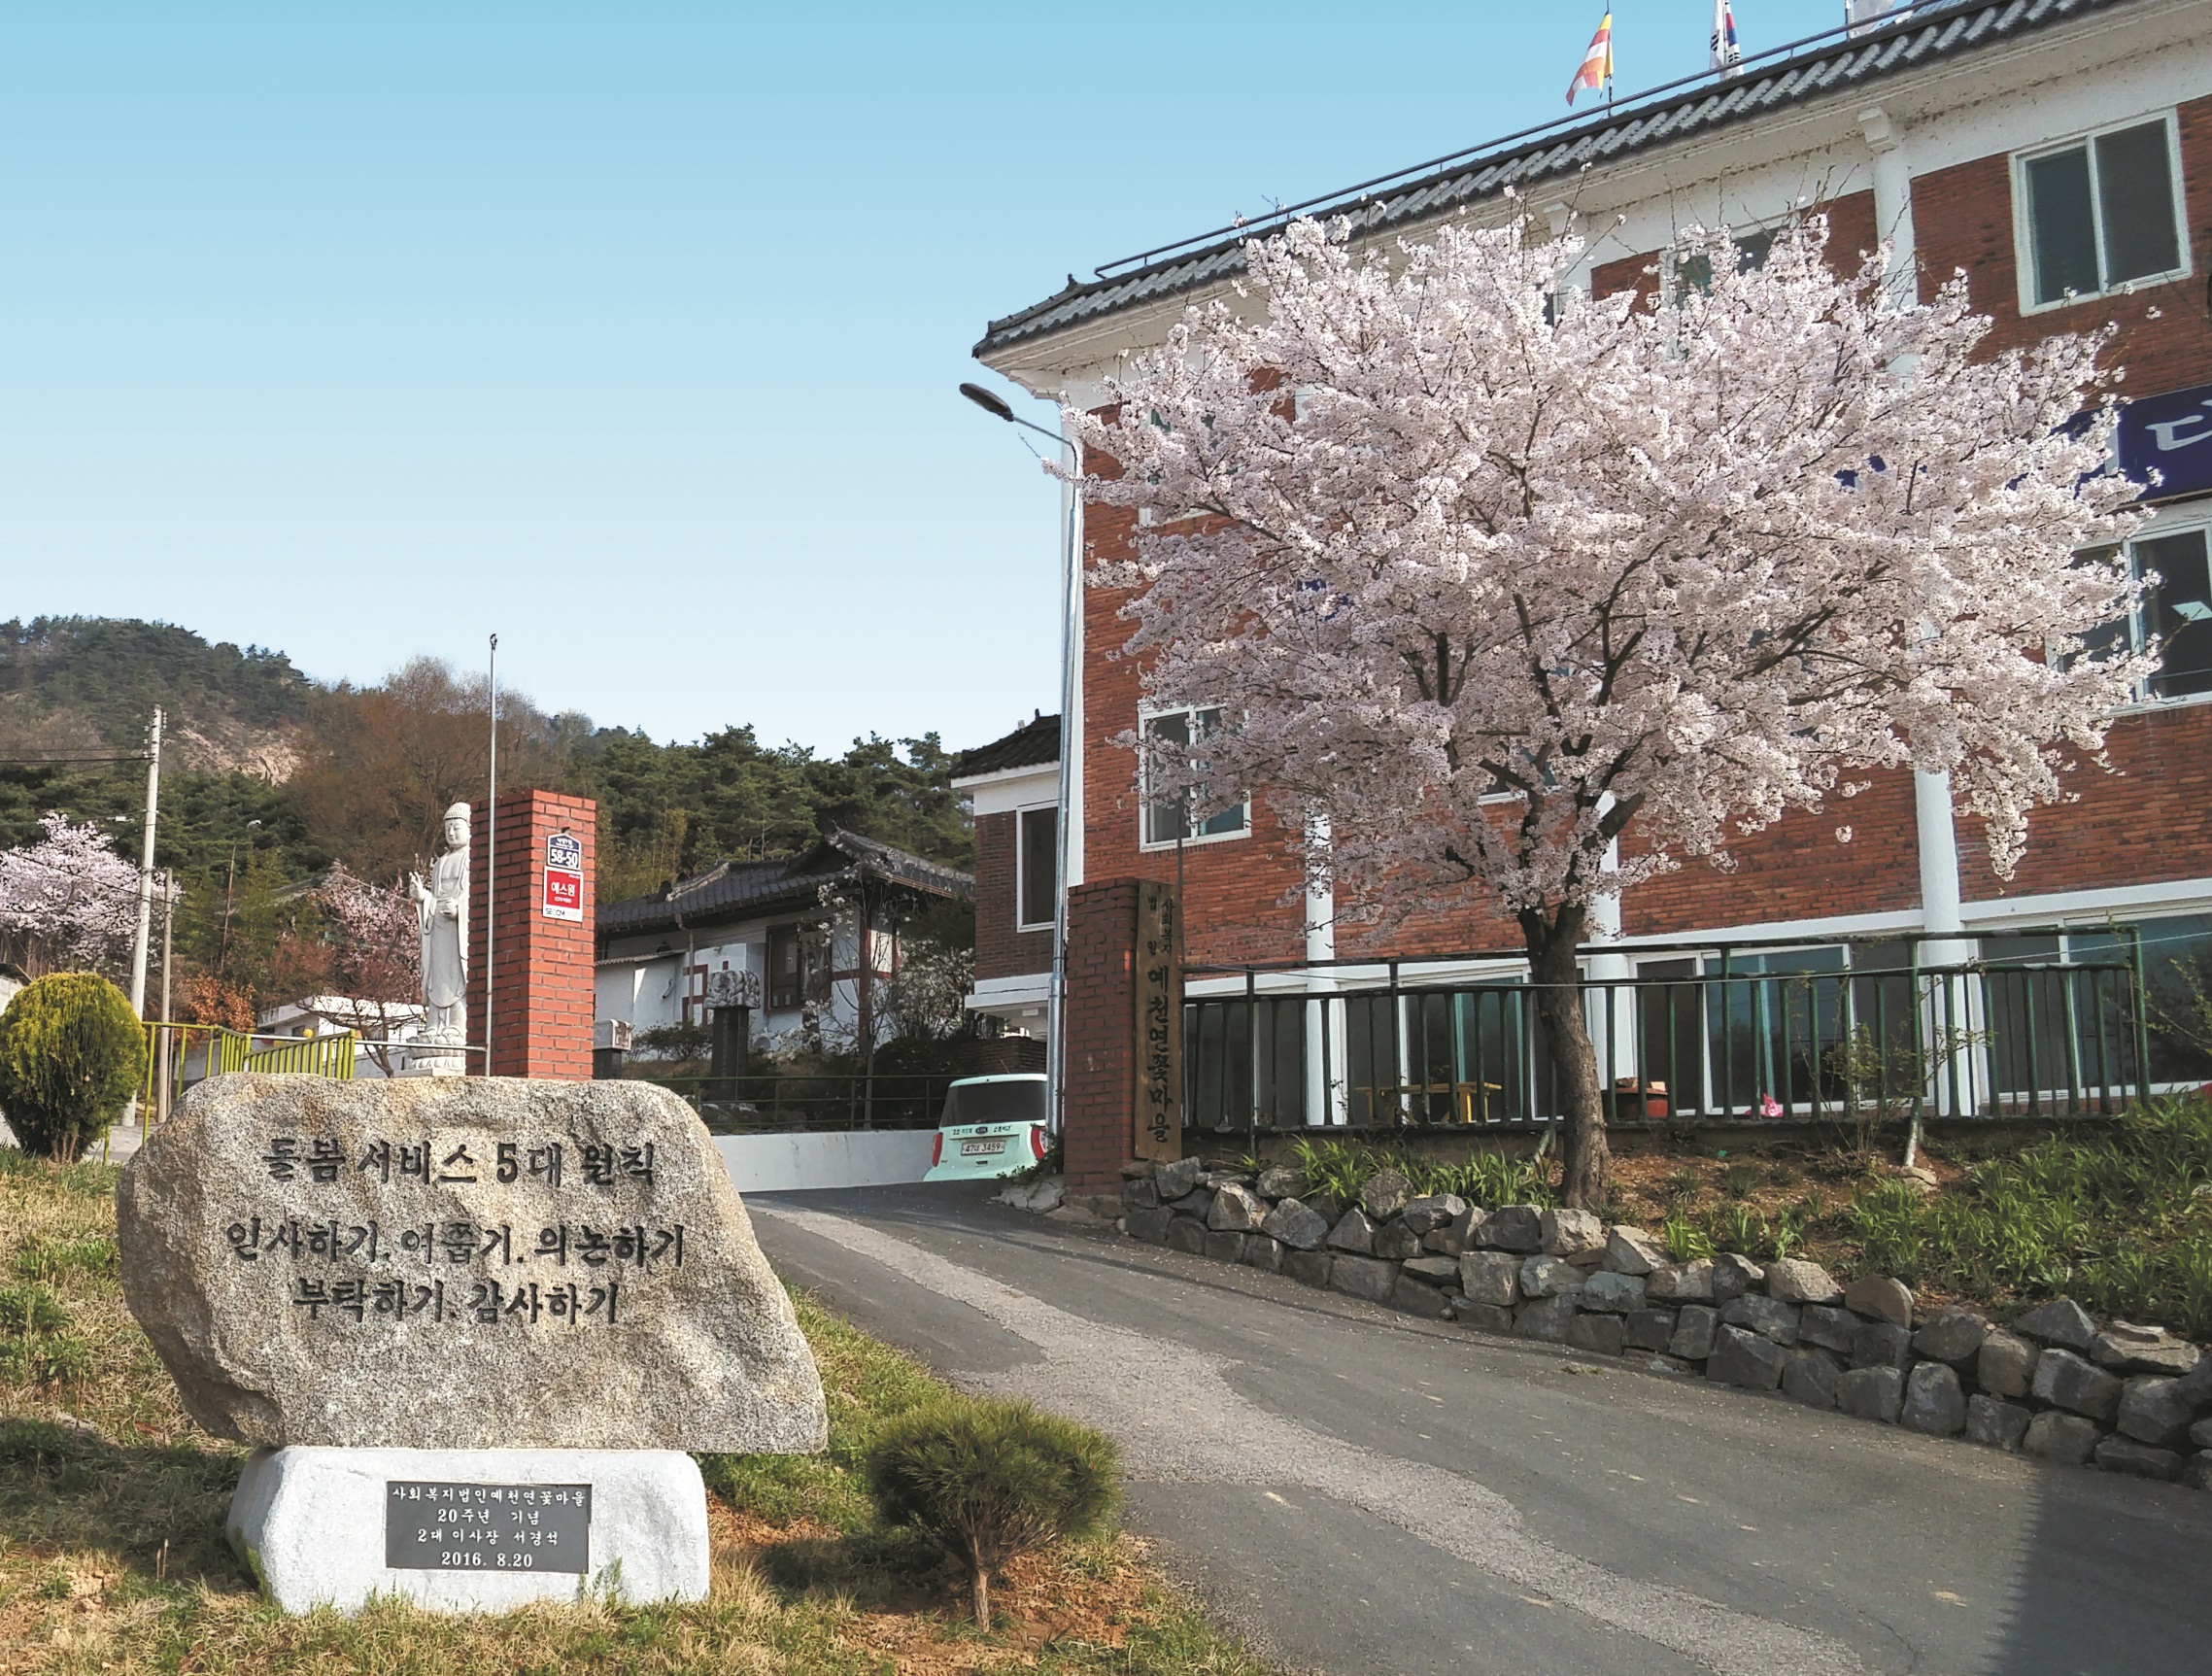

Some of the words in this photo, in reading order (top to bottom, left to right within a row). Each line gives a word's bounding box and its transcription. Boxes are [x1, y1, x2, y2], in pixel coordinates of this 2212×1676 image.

[551, 849, 577, 866] 58-50
[552, 882, 575, 896] 에스원
[1161, 899, 1175, 955] 사회복지
[1147, 965, 1173, 1143] 예천연꽃마을
[261, 1138, 346, 1183] 돌봄
[357, 1140, 478, 1185] 서비스
[496, 1143, 562, 1187] 5대
[580, 1142, 656, 1187] 원칙
[533, 1223, 685, 1268] 의논하기
[466, 1281, 619, 1325] 감사하기
[437, 1508, 491, 1524] 20주년
[511, 1510, 540, 1525] 기념
[417, 1528, 443, 1544] 2대
[452, 1528, 499, 1545] 이사장
[513, 1530, 559, 1547] 서경석
[496, 1553, 533, 1568] 8.20
